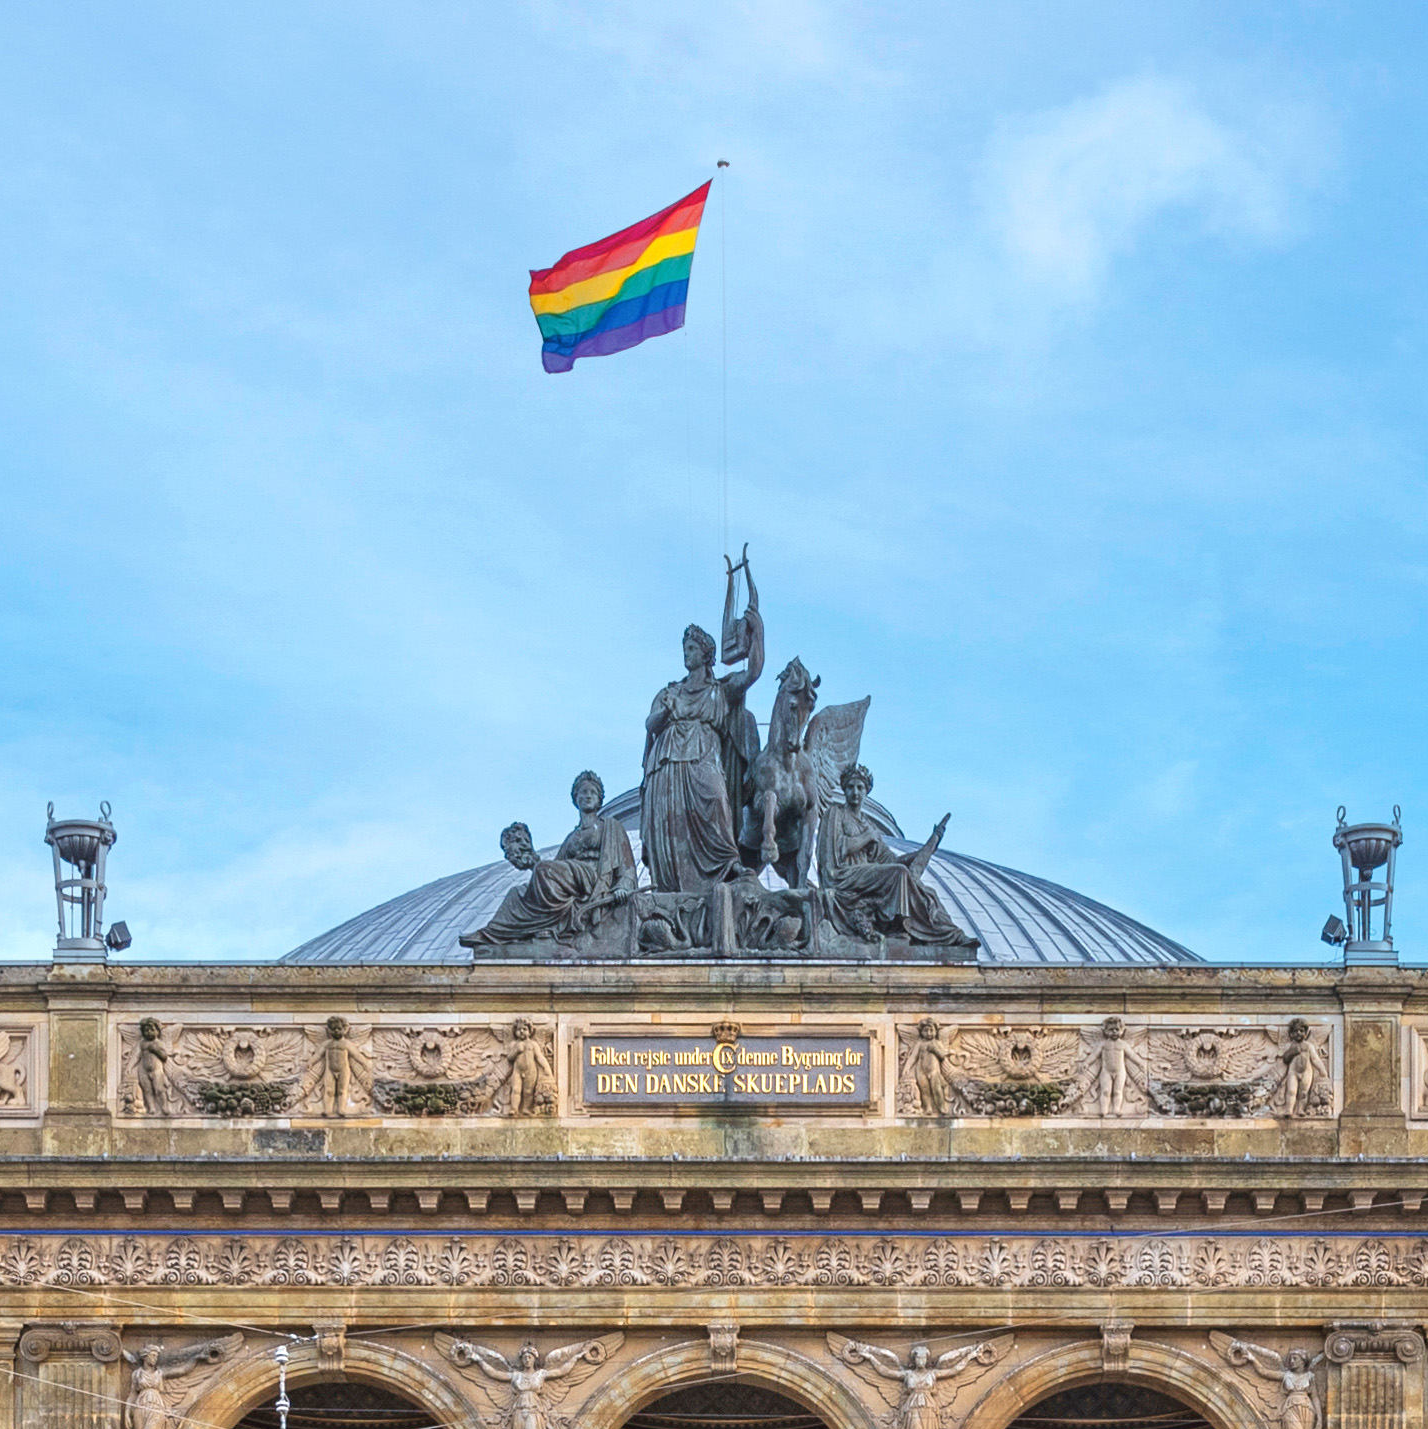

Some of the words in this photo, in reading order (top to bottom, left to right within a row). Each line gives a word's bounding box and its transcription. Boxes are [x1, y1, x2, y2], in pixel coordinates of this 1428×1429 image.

[590, 1045, 632, 1067] Folket
[634, 1048, 672, 1071] rejste
[674, 1046, 714, 1067] under
[737, 1047, 779, 1067] denne
[780, 1045, 844, 1071] Bygning
[845, 1047, 865, 1067] for
[597, 1073, 640, 1095] DEN
[645, 1073, 727, 1095] DANSKE
[733, 1073, 856, 1095] SKUEPLADS
